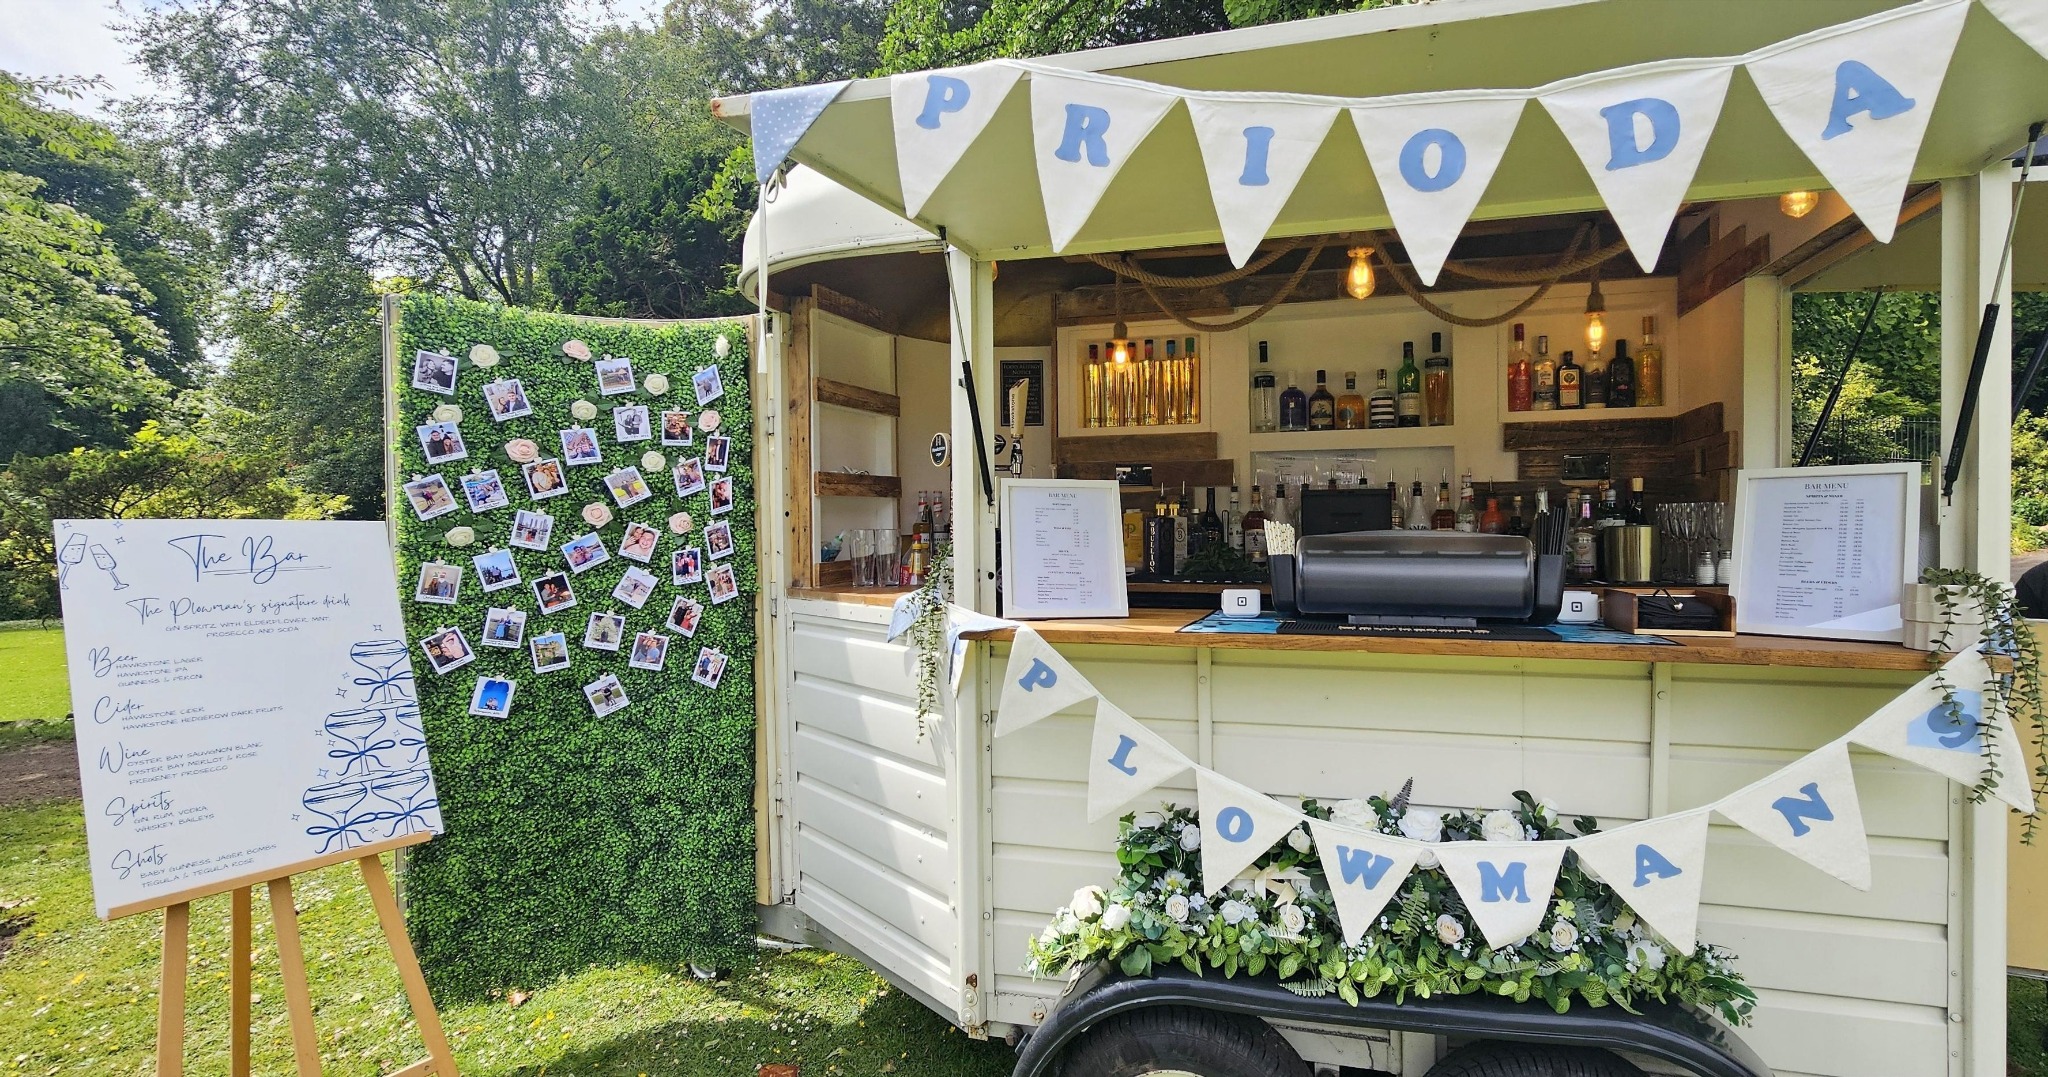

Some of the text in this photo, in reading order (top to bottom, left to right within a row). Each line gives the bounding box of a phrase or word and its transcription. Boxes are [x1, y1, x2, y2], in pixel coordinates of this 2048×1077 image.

[1804, 482, 1849, 490] BAR MENU
[167, 534, 308, 584] The Bar
[126, 593, 351, 625] The Plowman's signature drink
[184, 622, 217, 630] SPRITZ
[219, 620, 241, 628] WITH
[206, 629, 255, 638] PROSECCO
[88, 646, 138, 678] Beer
[116, 656, 204, 669] HAWKSTONE LAGER
[117, 668, 171, 678] HAWKSTONE
[94, 695, 144, 724] Cider
[122, 710, 177, 721] HAWKSTONE
[123, 705, 284, 731] HAWKSTONE HEDGEROW DARK FRUITS
[99, 741, 151, 774] Wine
[126, 756, 163, 767] OYSTER
[166, 753, 184, 762] BAY
[234, 742, 263, 751] BLANC
[128, 765, 164, 776] OYSTER
[167, 762, 184, 771] BAY
[187, 757, 225, 767] MERLOT
[180, 764, 228, 777] PROSECCO
[105, 790, 174, 827] Spirits
[178, 813, 215, 825] BAILEYS
[111, 844, 168, 880] Shots
[140, 869, 165, 879] BABY
[246, 843, 277, 855] BOMBS
[141, 874, 180, 889] TEQUILA
[192, 863, 229, 876] TEQUILA
